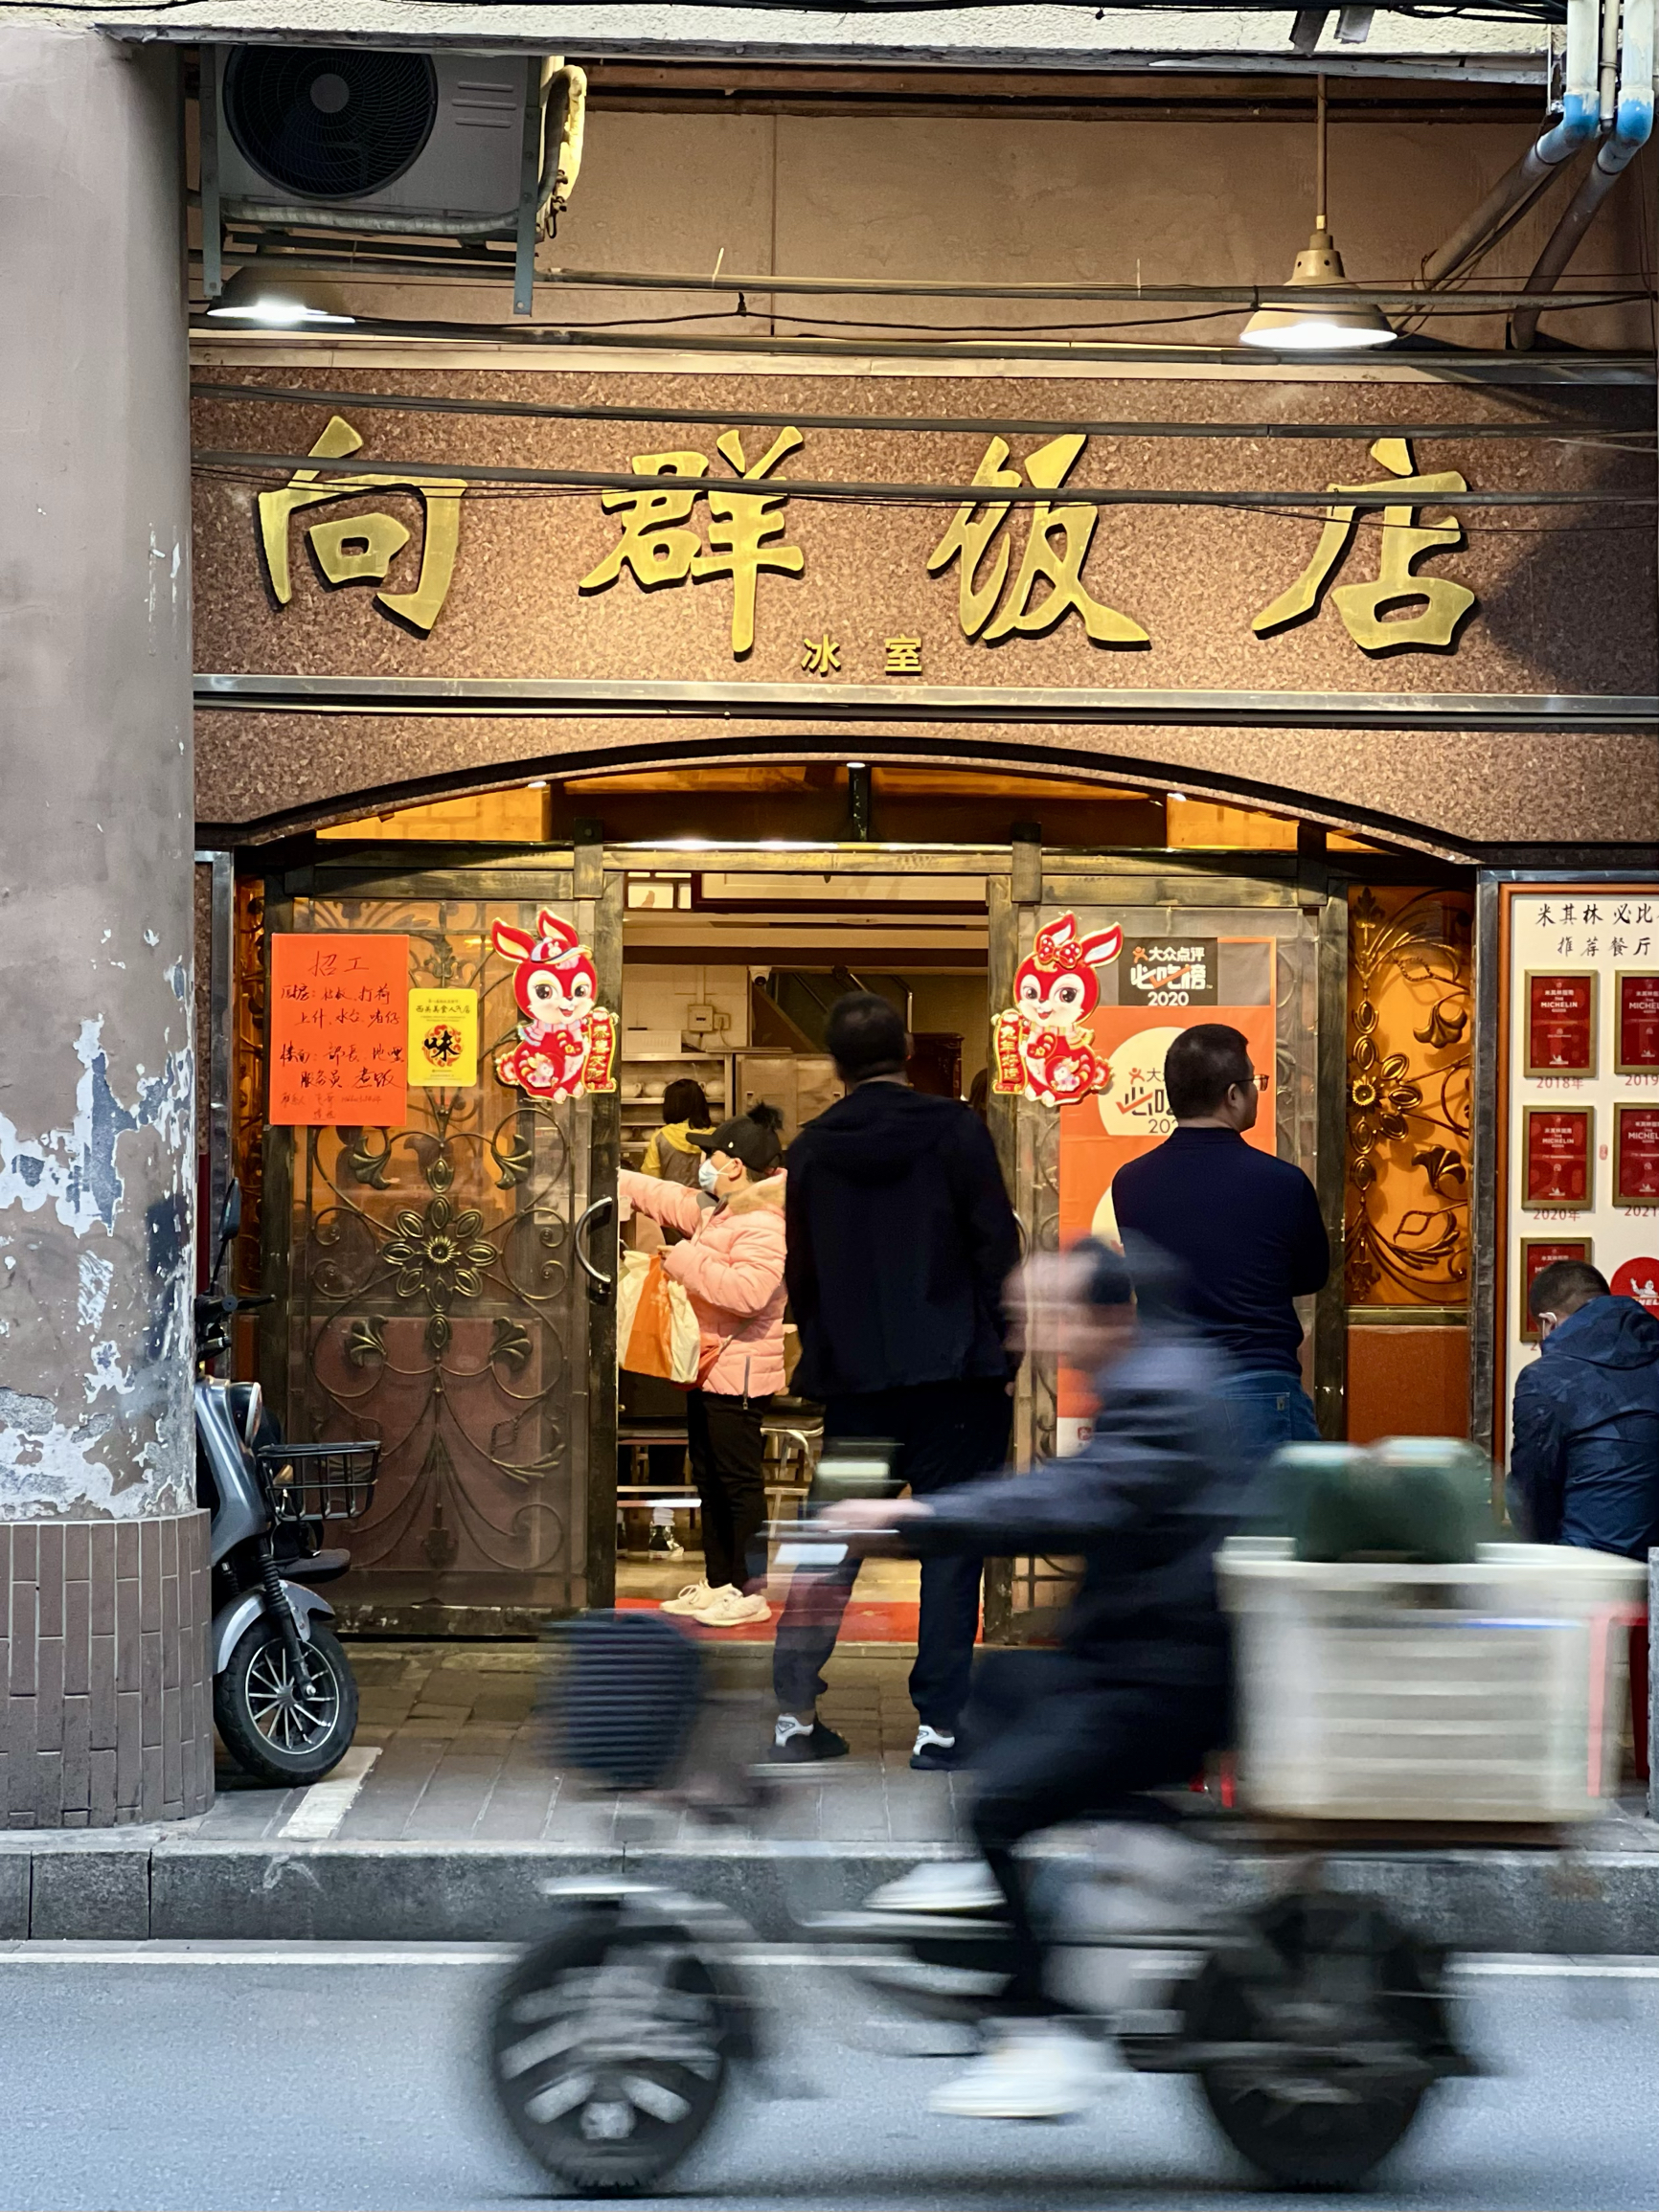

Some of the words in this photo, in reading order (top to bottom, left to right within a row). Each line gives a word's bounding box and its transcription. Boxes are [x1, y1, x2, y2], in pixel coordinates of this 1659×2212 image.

[259, 415, 1474, 653] 向群饭店
[801, 634, 922, 674] 冰室
[1613, 903, 1659, 925] 必比
[1148, 946, 1205, 961] 大众点评
[1557, 937, 1650, 957] 推荐餐厅
[307, 950, 370, 978] 招工
[1130, 963, 1206, 990] 必吃榜
[1148, 991, 1190, 1006] 2020
[424, 1029, 461, 1062] 味
[587, 1025, 610, 1081] 恭喜发财
[1000, 1026, 1019, 1082] 兔年好运
[1536, 1076, 1583, 1090] 2018年
[1148, 1118, 1177, 1134] 20
[1534, 1208, 1580, 1221] 2020年
[1625, 1206, 1656, 1217] 2021
